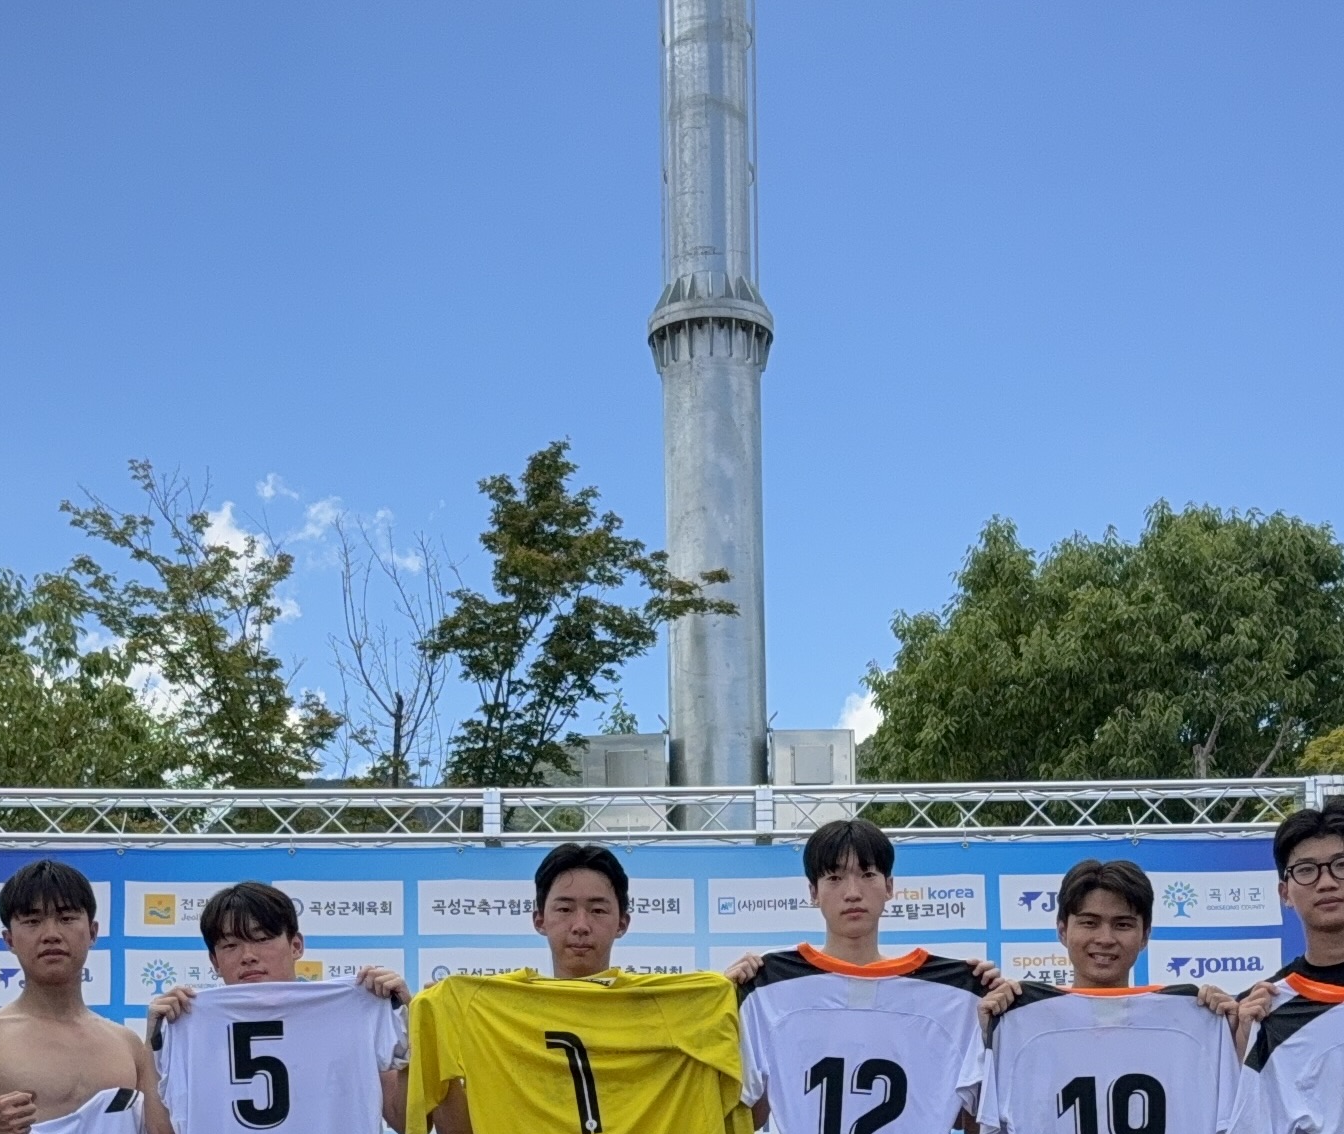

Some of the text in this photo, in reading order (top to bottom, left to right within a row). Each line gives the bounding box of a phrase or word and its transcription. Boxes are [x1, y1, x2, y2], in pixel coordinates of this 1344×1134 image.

[928, 887, 974, 899] korea
[1208, 888, 1261, 902] 곡성군
[308, 900, 392, 916] 곡성군체육회
[432, 899, 536, 915] 곡성군축구협회
[226, 1020, 290, 1131] 5
